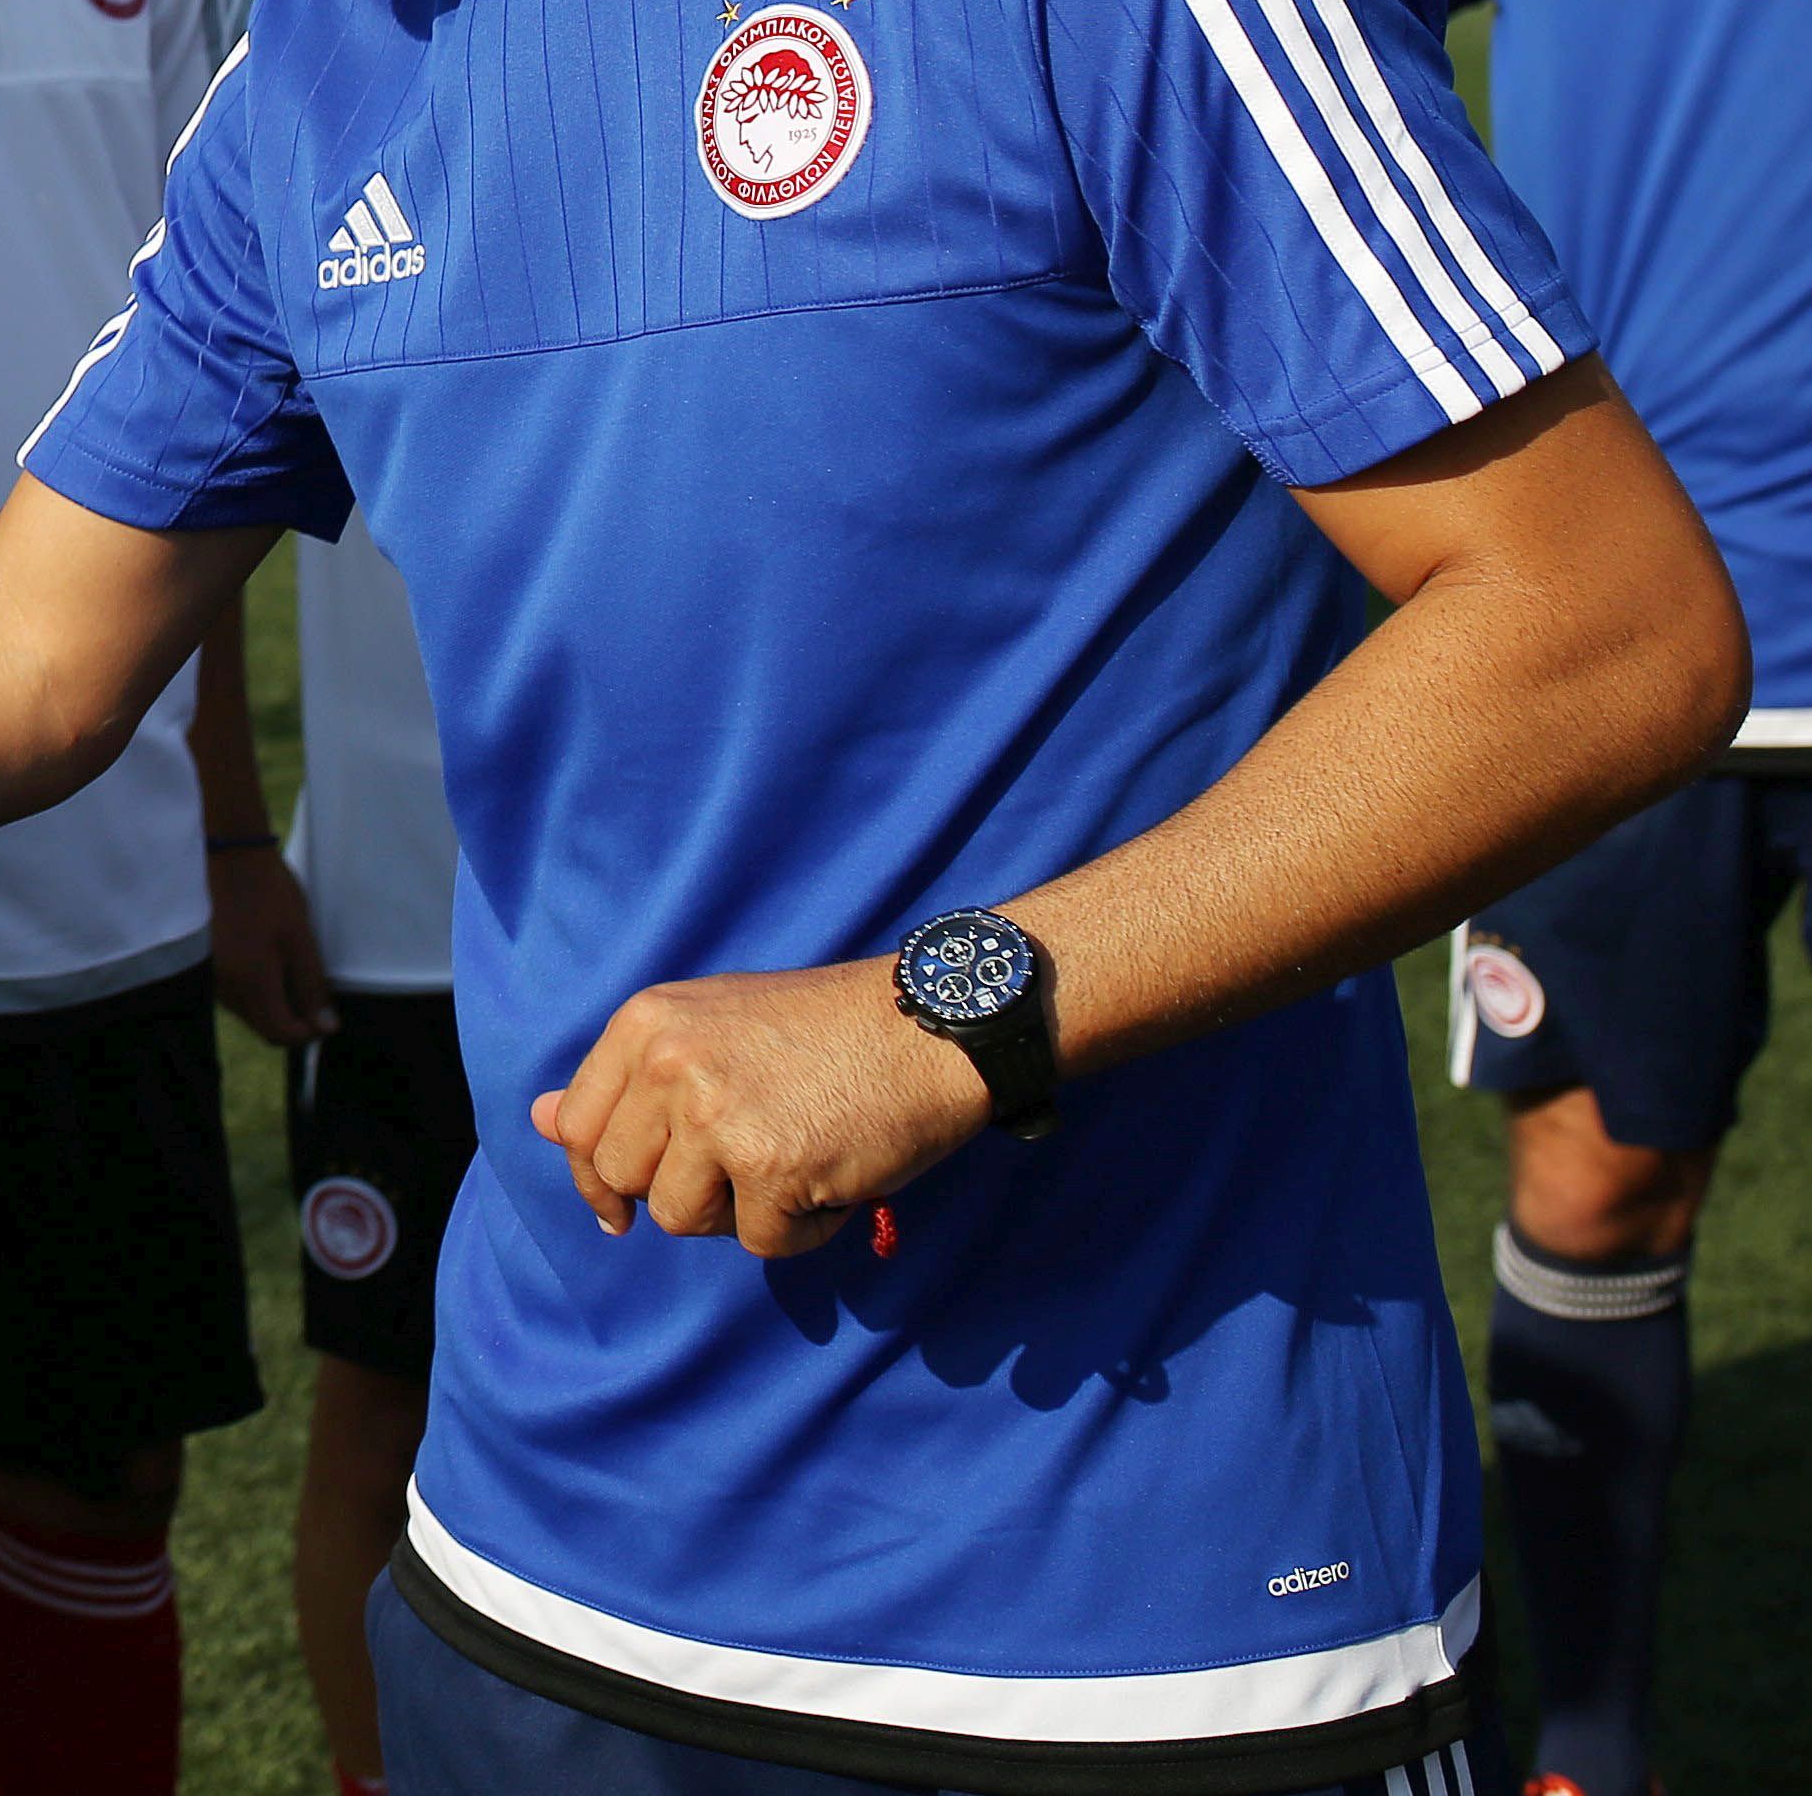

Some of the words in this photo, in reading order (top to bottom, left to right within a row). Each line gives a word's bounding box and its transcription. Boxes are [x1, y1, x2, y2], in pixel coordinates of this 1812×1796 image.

[719, 17, 832, 69] ΟΛΥΜΠΙΑΚΟΣ
[826, 50, 857, 149] ΠΕΙΡΑΙΩΣ
[702, 73, 736, 191] ΣΥΝΔΕΣΜΟΣ
[788, 127, 818, 144] 1925
[737, 152, 835, 203] ΦΙΛΑΘΛΩΝ
[317, 241, 427, 291] adidas
[1267, 1560, 1351, 1598] adizero
